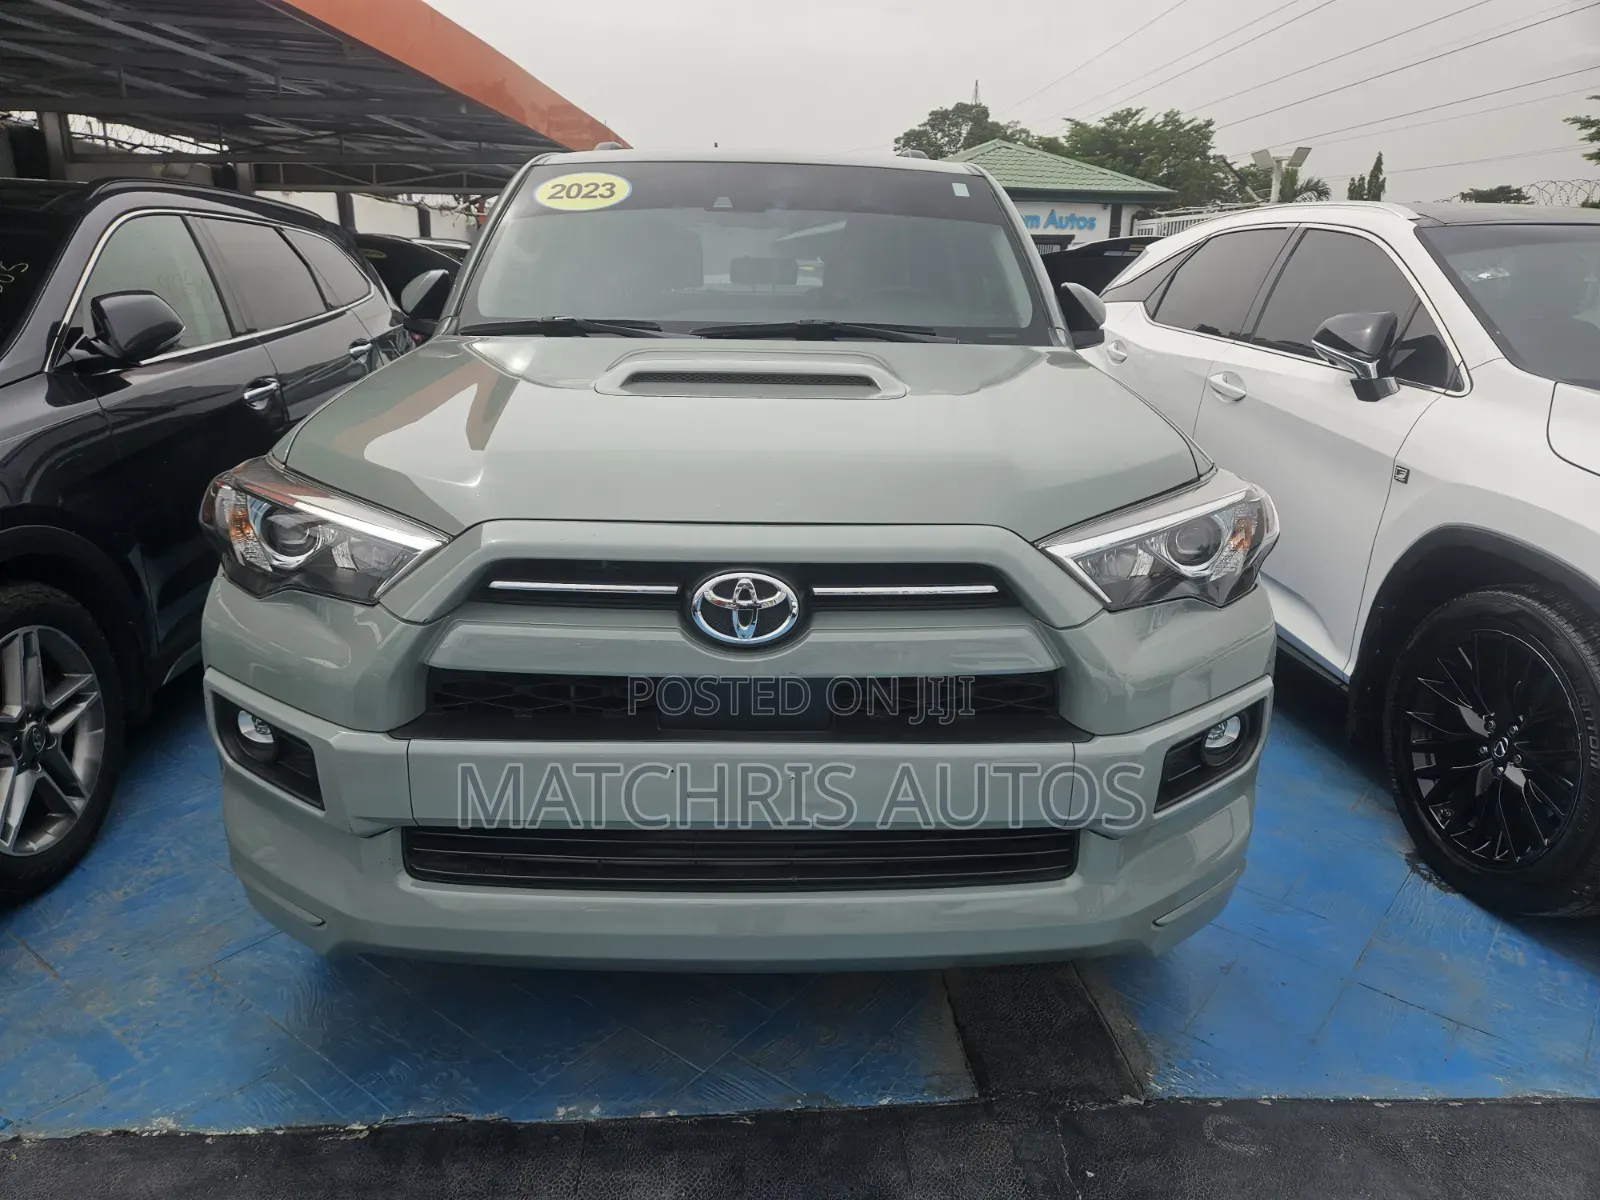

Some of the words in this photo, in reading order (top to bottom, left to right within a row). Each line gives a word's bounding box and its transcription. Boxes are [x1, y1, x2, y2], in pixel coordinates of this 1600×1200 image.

[547, 182, 616, 200] 2023
[1020, 215, 1041, 229] m
[1043, 208, 1097, 231] Autos
